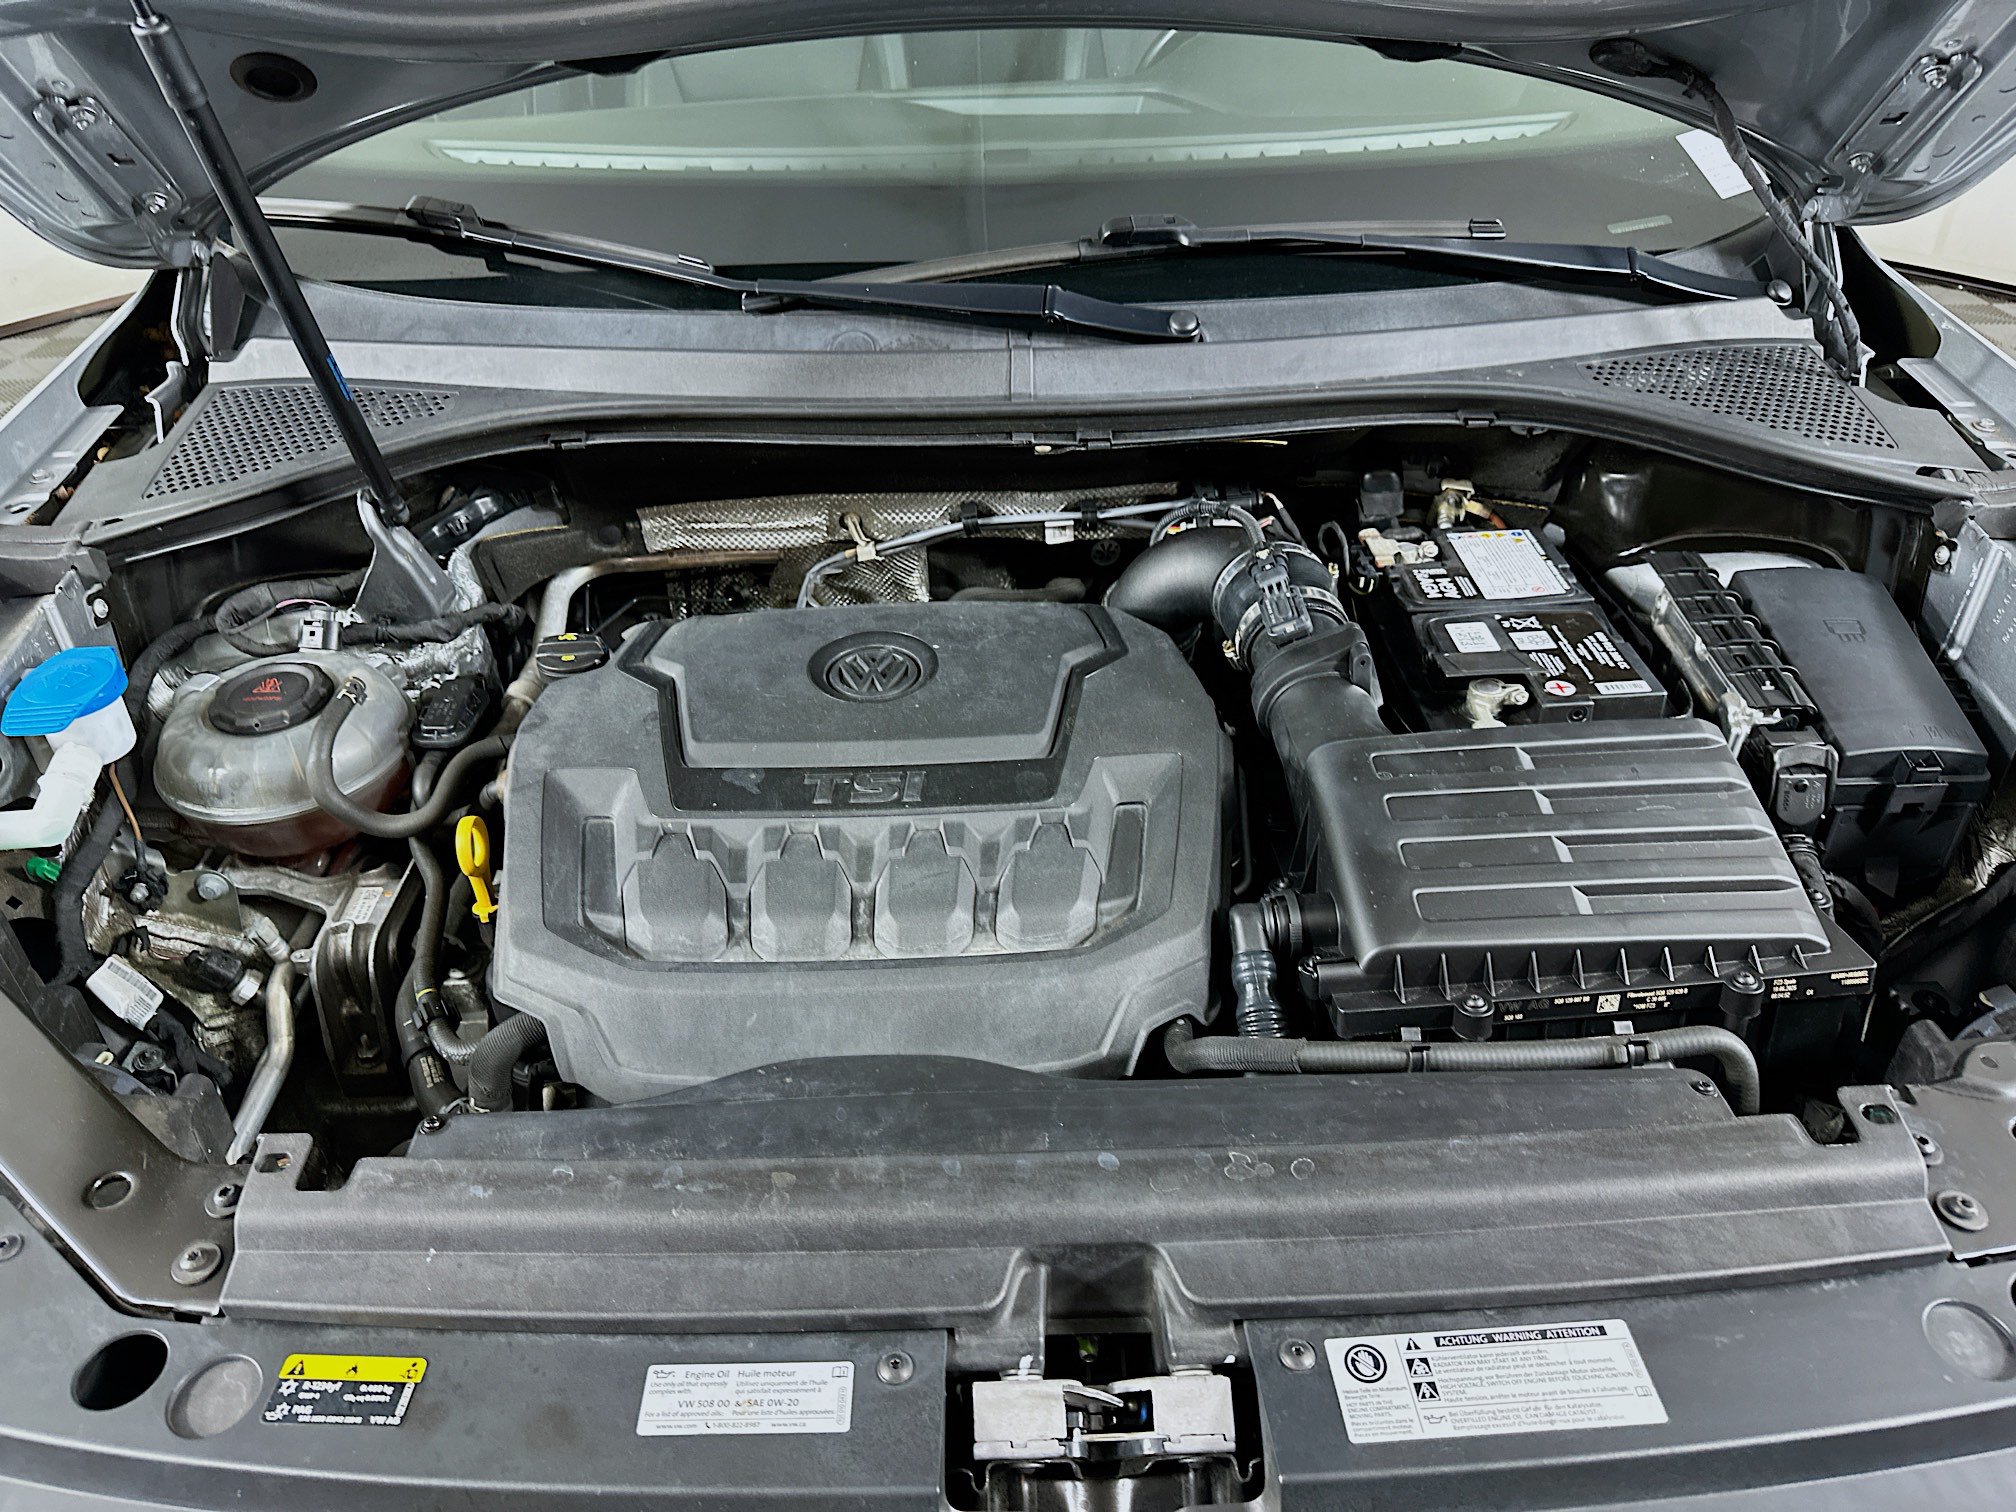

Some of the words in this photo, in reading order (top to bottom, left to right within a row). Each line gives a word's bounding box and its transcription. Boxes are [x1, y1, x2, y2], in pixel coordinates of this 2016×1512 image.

[803, 771, 926, 804] TSI
[1440, 1334, 1488, 1346] ACHTUNG
[1492, 1330, 1542, 1342] WARNING
[1546, 1326, 1600, 1339] ATTENTION
[685, 1370, 715, 1380] Engine
[717, 1370, 730, 1378] Oil
[738, 1370, 761, 1378] Huile
[663, 1381, 675, 1389] only
[700, 1381, 728, 1389] expressly
[773, 1387, 816, 1395] expressément
[678, 1400, 695, 1408] VW
[697, 1400, 715, 1408] 508
[717, 1399, 731, 1407] 00
[747, 1399, 765, 1407] SAE
[767, 1398, 800, 1407] 0W-20
